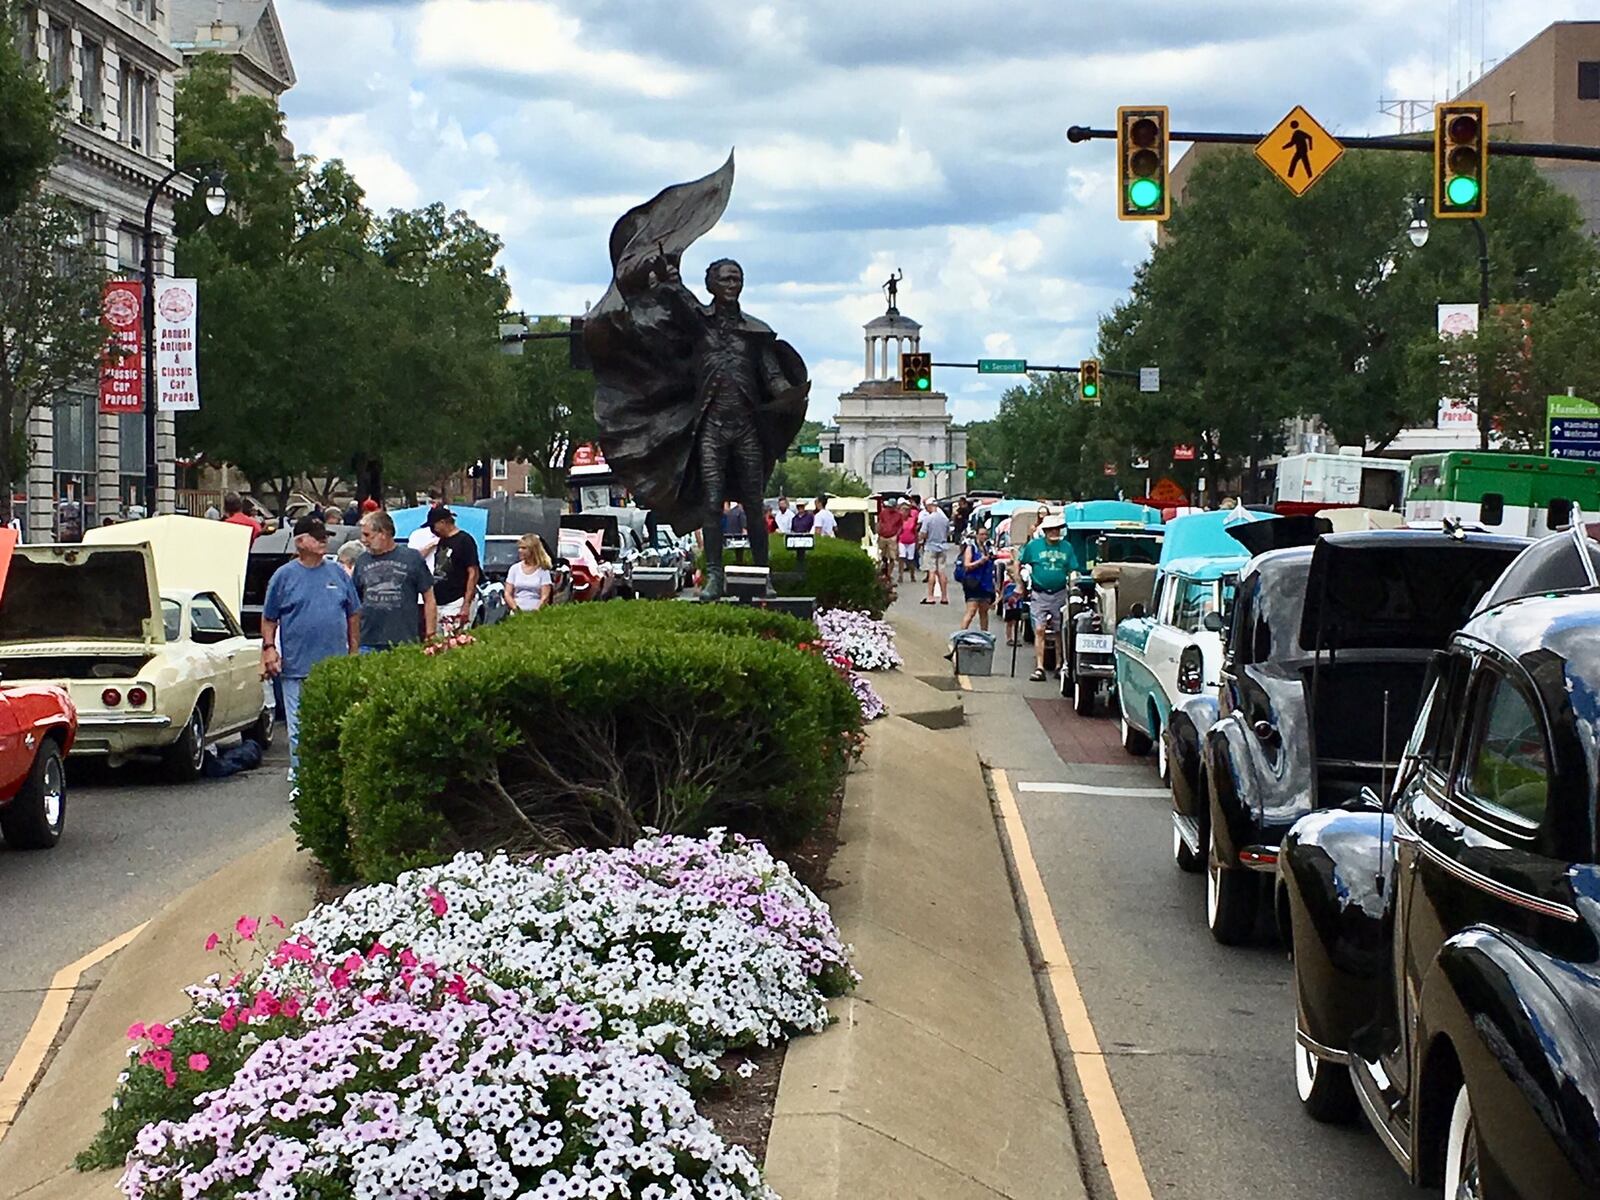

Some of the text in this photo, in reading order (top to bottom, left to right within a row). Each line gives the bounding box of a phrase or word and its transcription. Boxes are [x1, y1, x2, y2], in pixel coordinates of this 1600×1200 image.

[162, 328, 190, 338] Annual
[160, 342, 192, 352] Antique
[174, 353, 180, 364] &
[161, 367, 192, 377] Classic
[113, 381, 130, 392] Car
[170, 380, 186, 389] Car
[105, 394, 138, 405] Parade
[162, 392, 194, 402] Parade
[1550, 403, 1599, 414] Hamilton
[1442, 411, 1473, 421] Parade
[1563, 421, 1599, 429] Hamilton
[1564, 430, 1598, 438] Welcome
